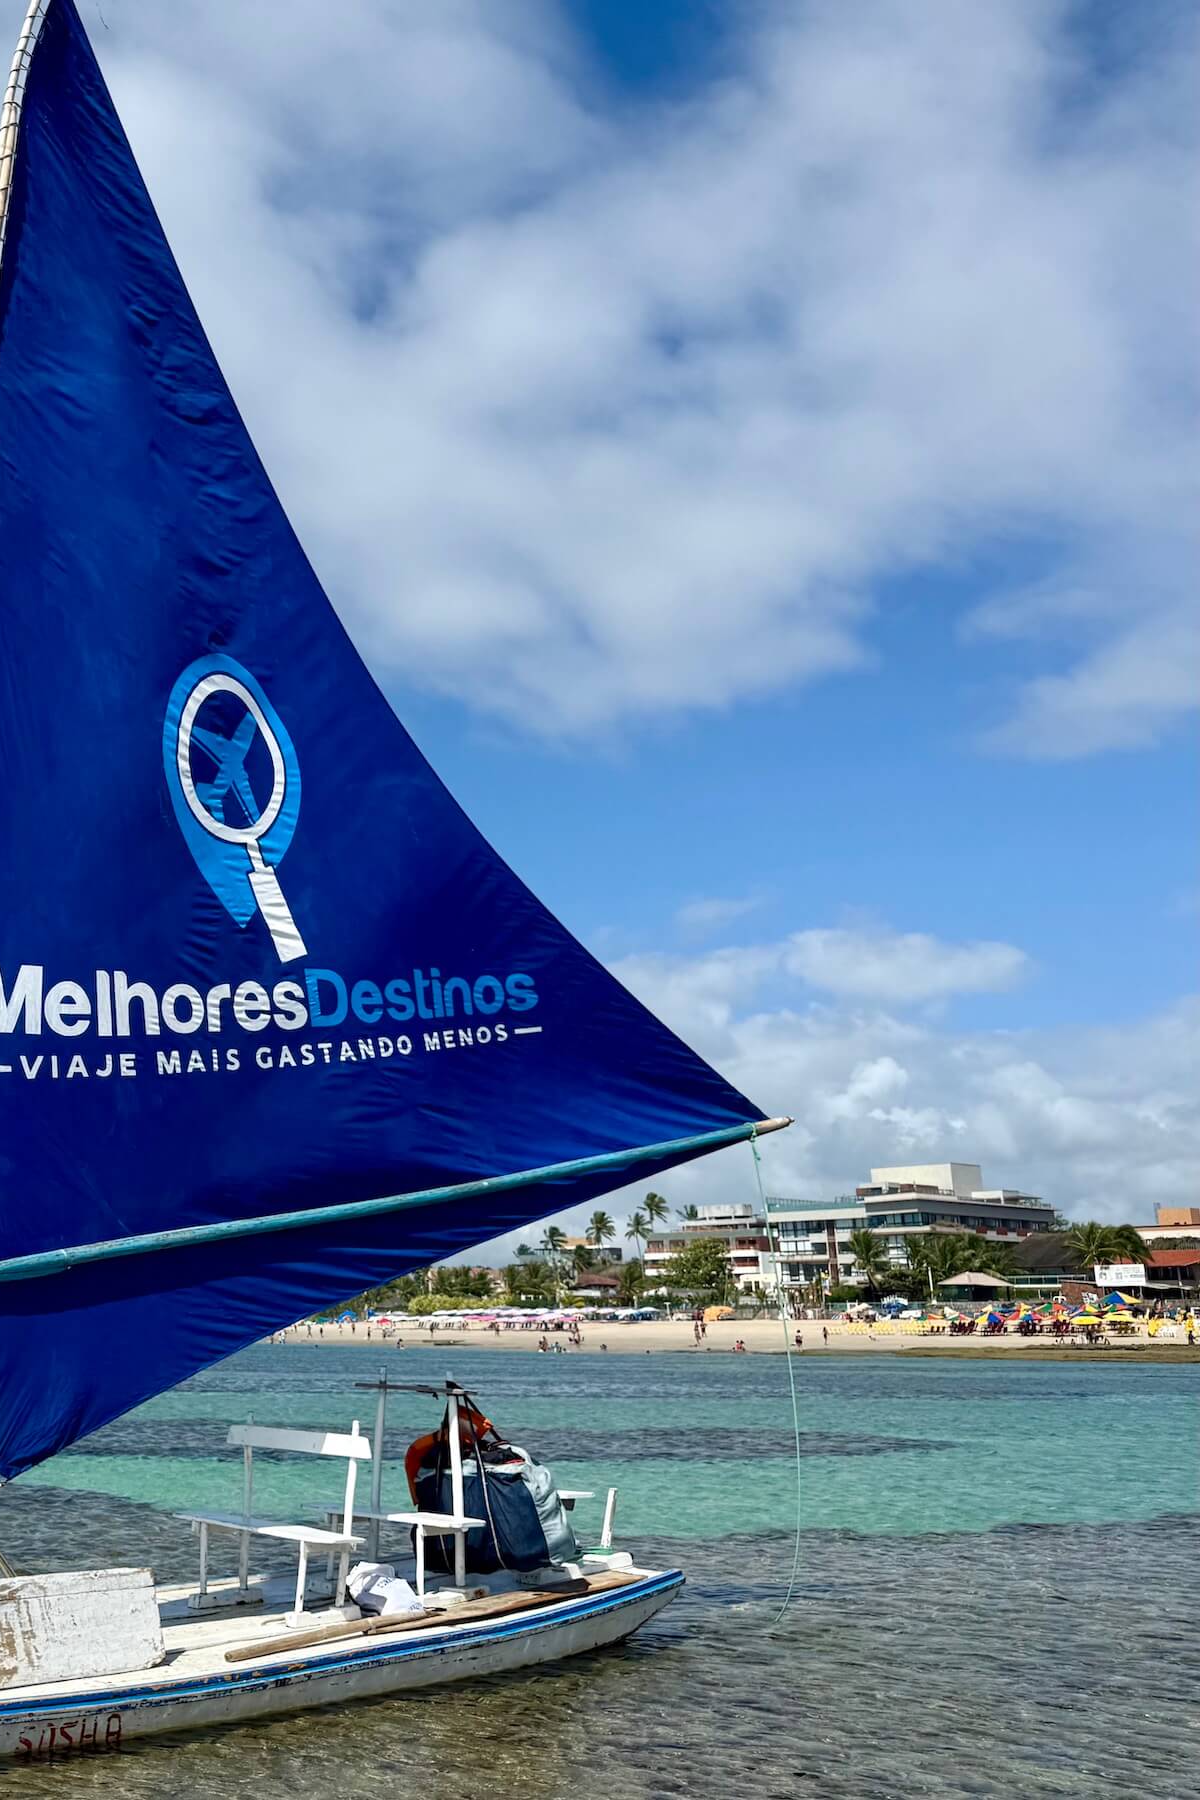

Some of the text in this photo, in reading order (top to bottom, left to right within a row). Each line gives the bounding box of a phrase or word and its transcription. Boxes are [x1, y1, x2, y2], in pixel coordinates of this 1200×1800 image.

[19, 1024, 509, 1080] VIAJE MAIS GASTANDO MENOS
